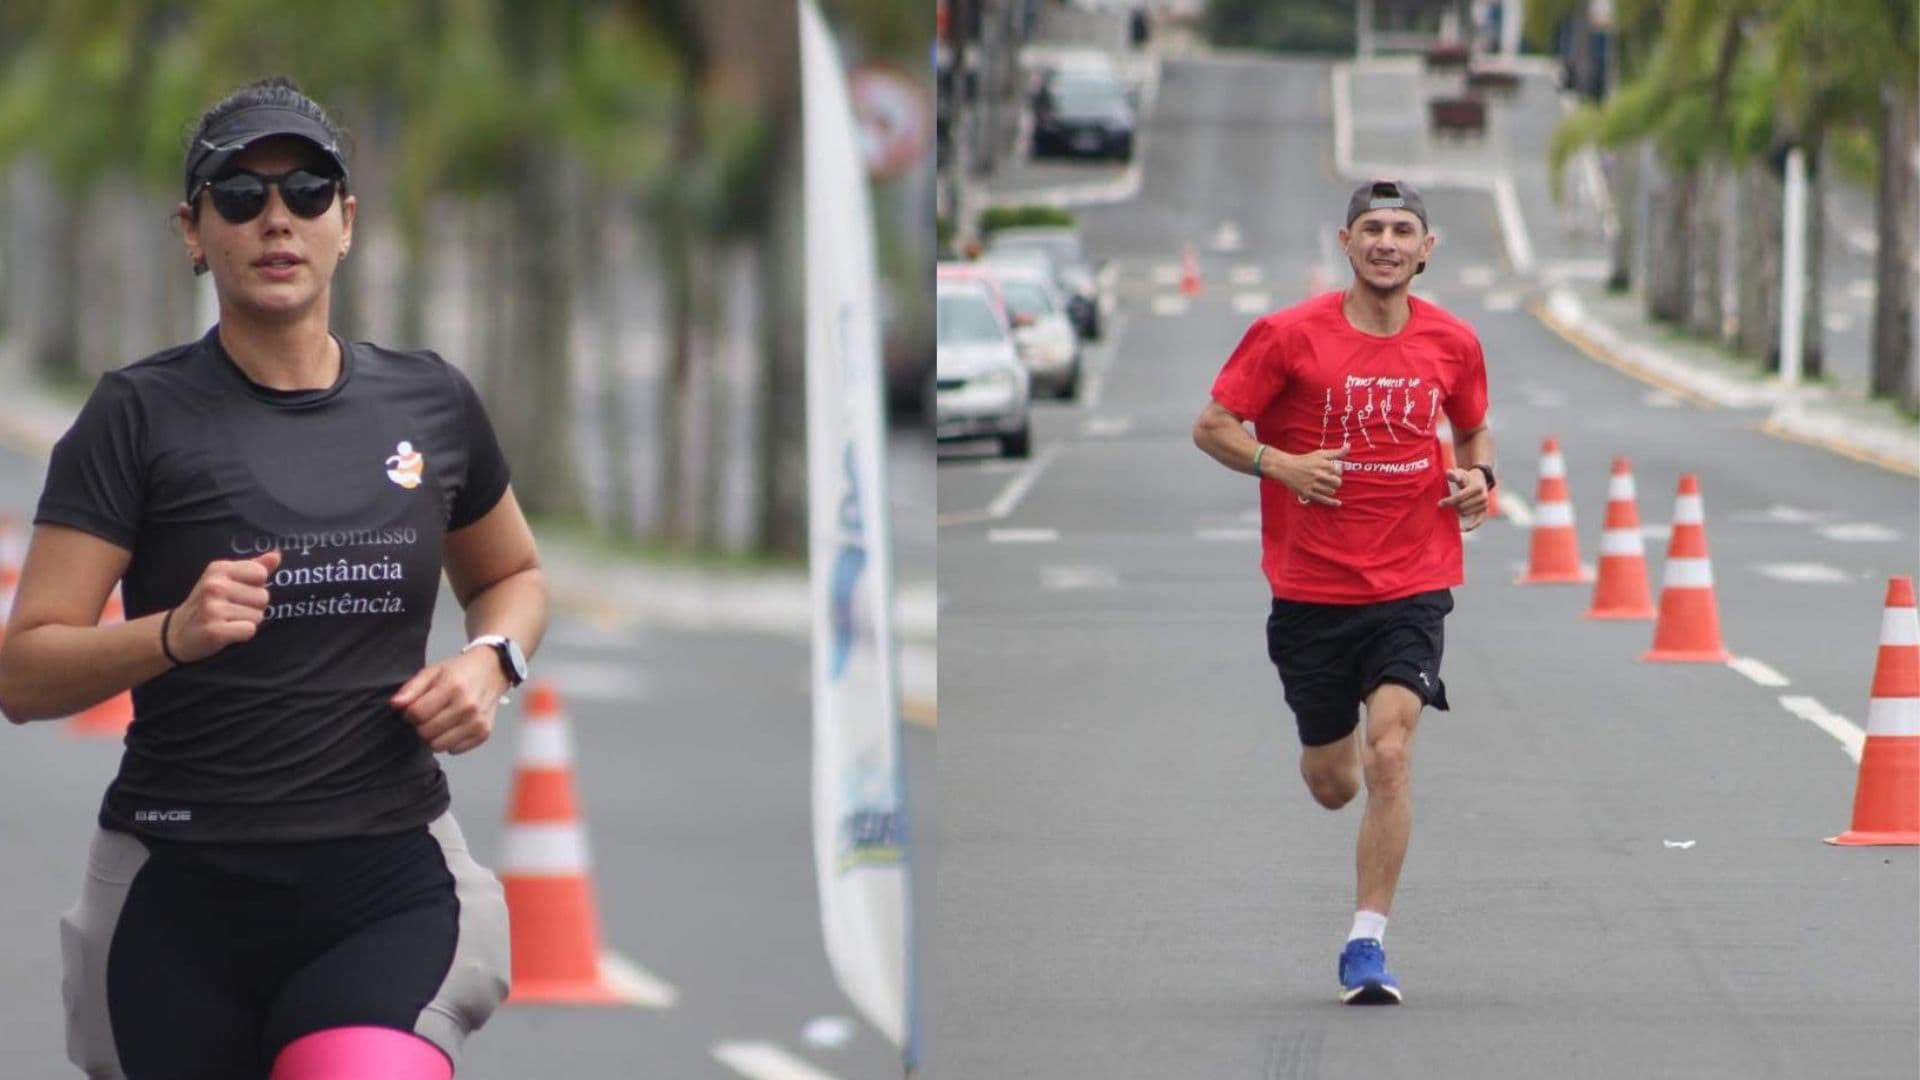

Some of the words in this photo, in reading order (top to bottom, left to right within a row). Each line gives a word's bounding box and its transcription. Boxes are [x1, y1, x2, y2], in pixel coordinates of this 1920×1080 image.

[1407, 377, 1421, 388] UP
[1363, 458, 1429, 473] GYMNASTICS
[231, 527, 417, 556] Compromisso
[263, 555, 403, 587] onstância
[263, 590, 406, 621] onsistência.
